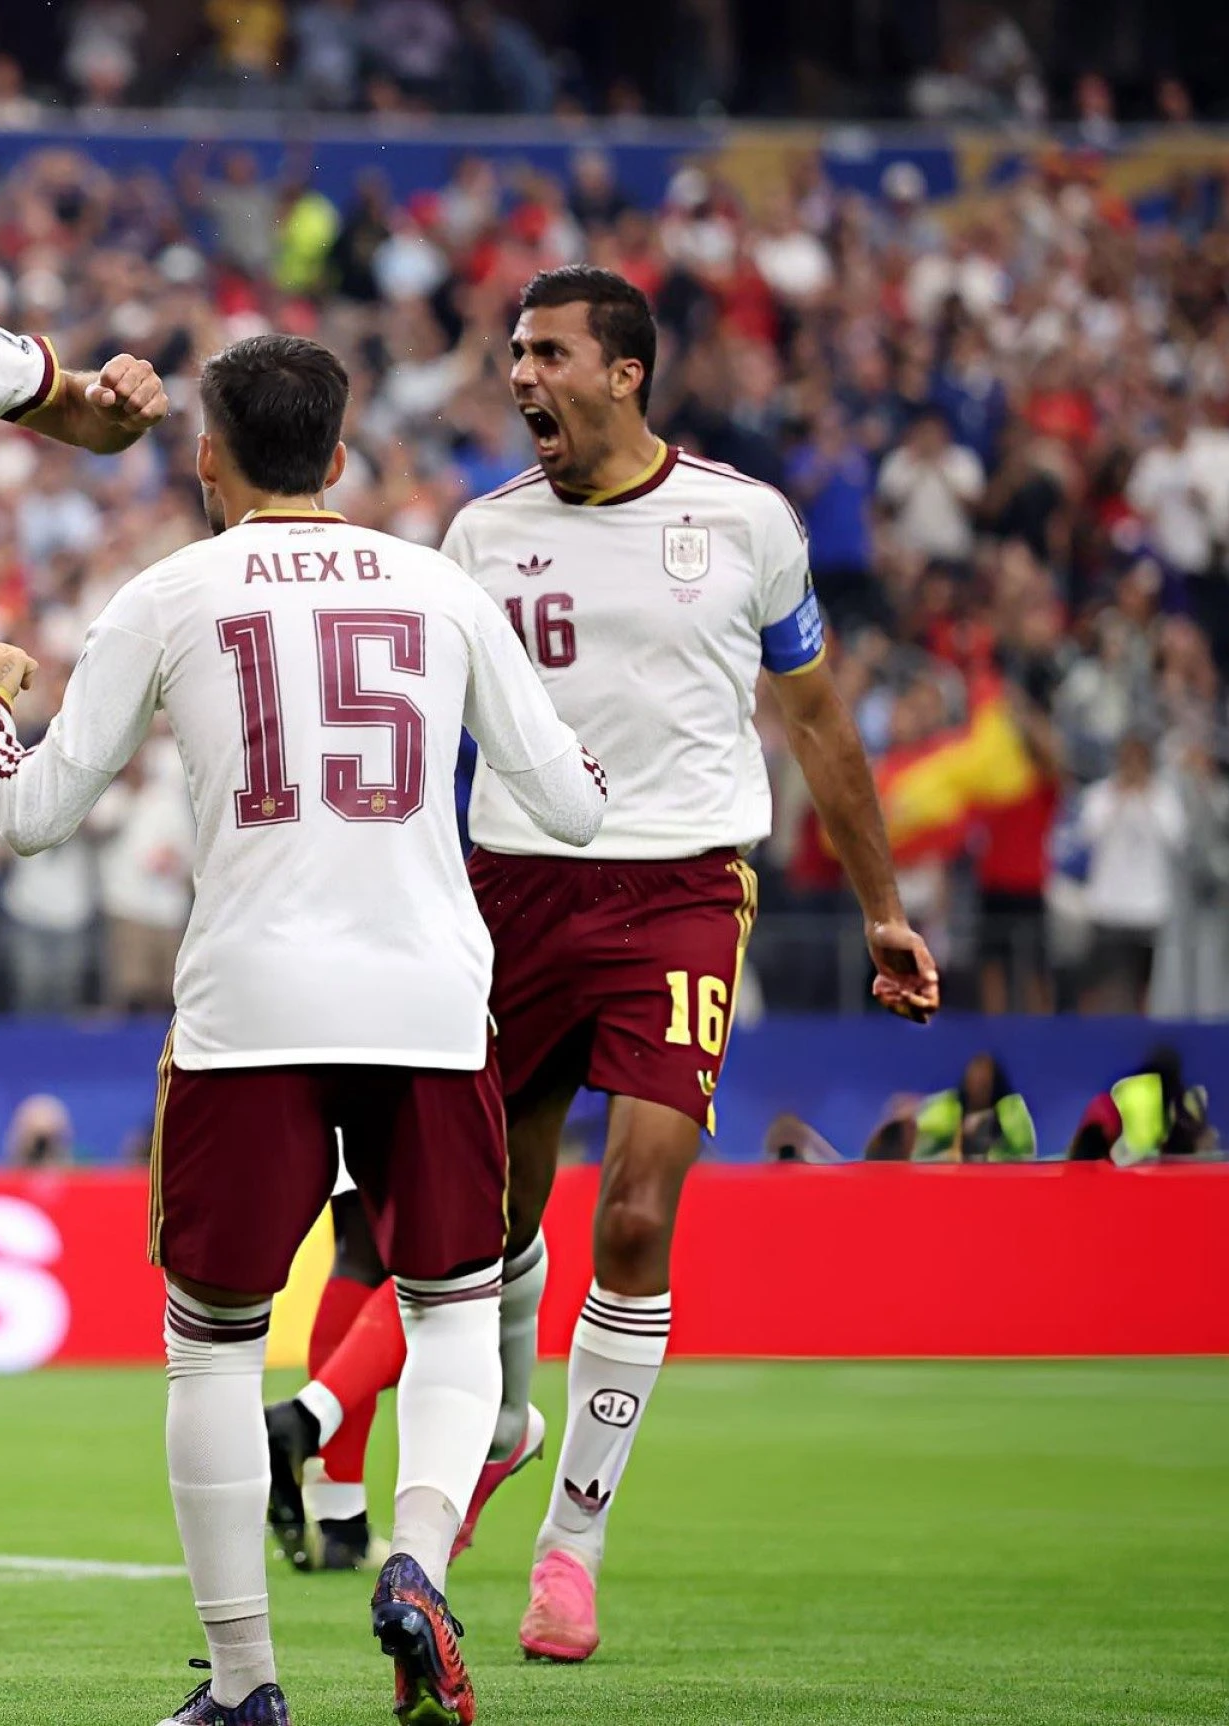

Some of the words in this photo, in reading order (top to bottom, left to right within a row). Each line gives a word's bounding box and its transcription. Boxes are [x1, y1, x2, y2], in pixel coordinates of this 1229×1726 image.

[245, 551, 344, 583] ALEX
[354, 549, 391, 581] B.
[505, 593, 576, 668] 16
[215, 609, 425, 829] 15
[665, 970, 727, 1056] 16
